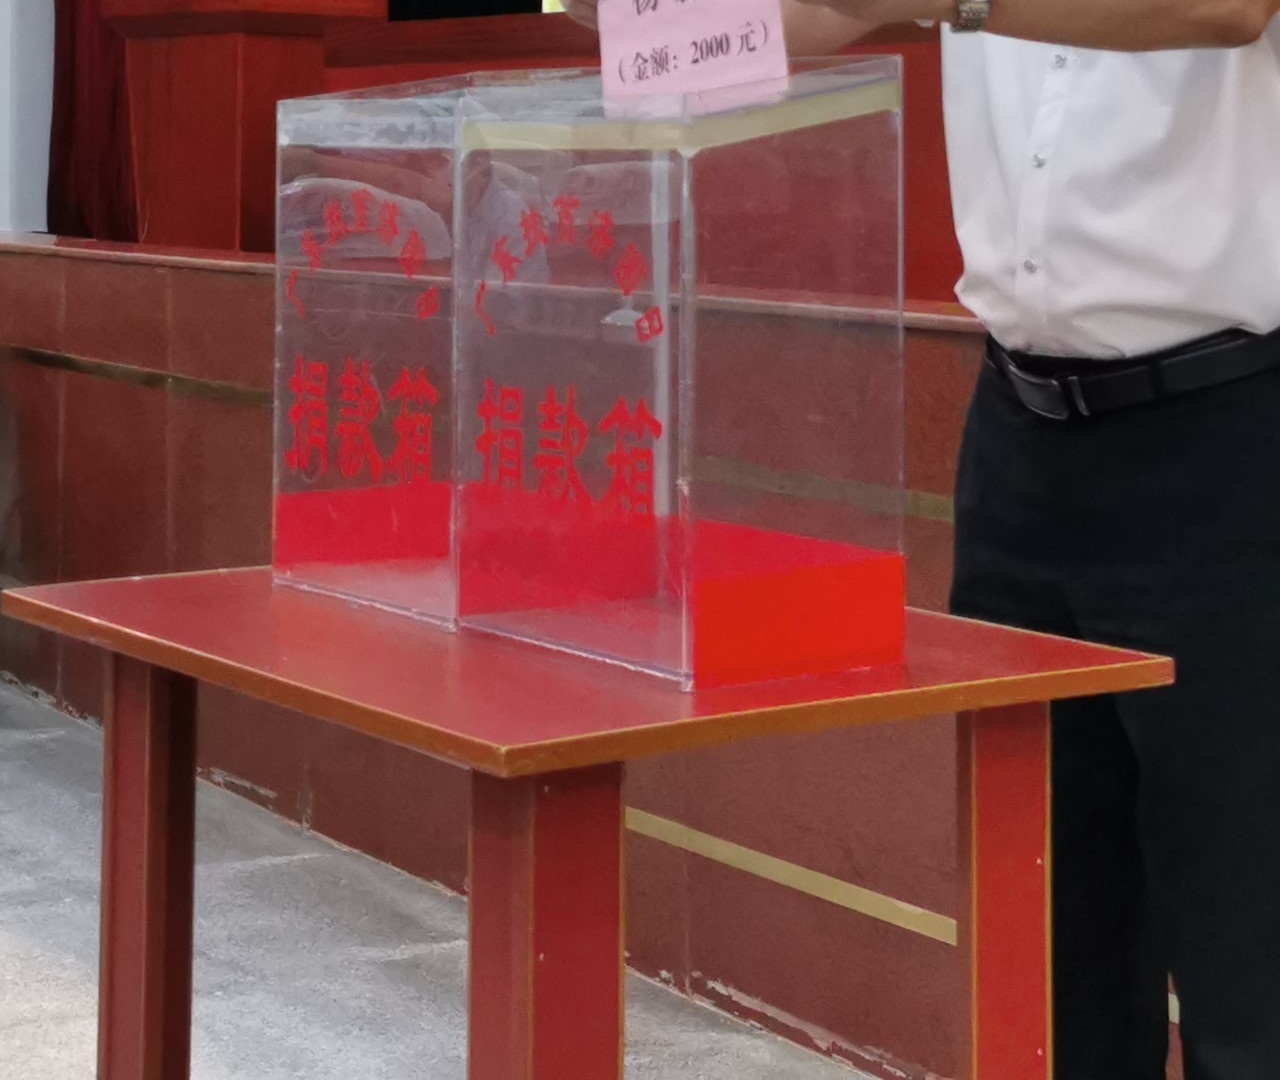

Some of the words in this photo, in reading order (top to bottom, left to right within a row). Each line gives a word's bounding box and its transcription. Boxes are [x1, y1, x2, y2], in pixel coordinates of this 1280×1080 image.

[285, 353, 440, 485] 捐款箱
[475, 377, 663, 520] 捐款箱
